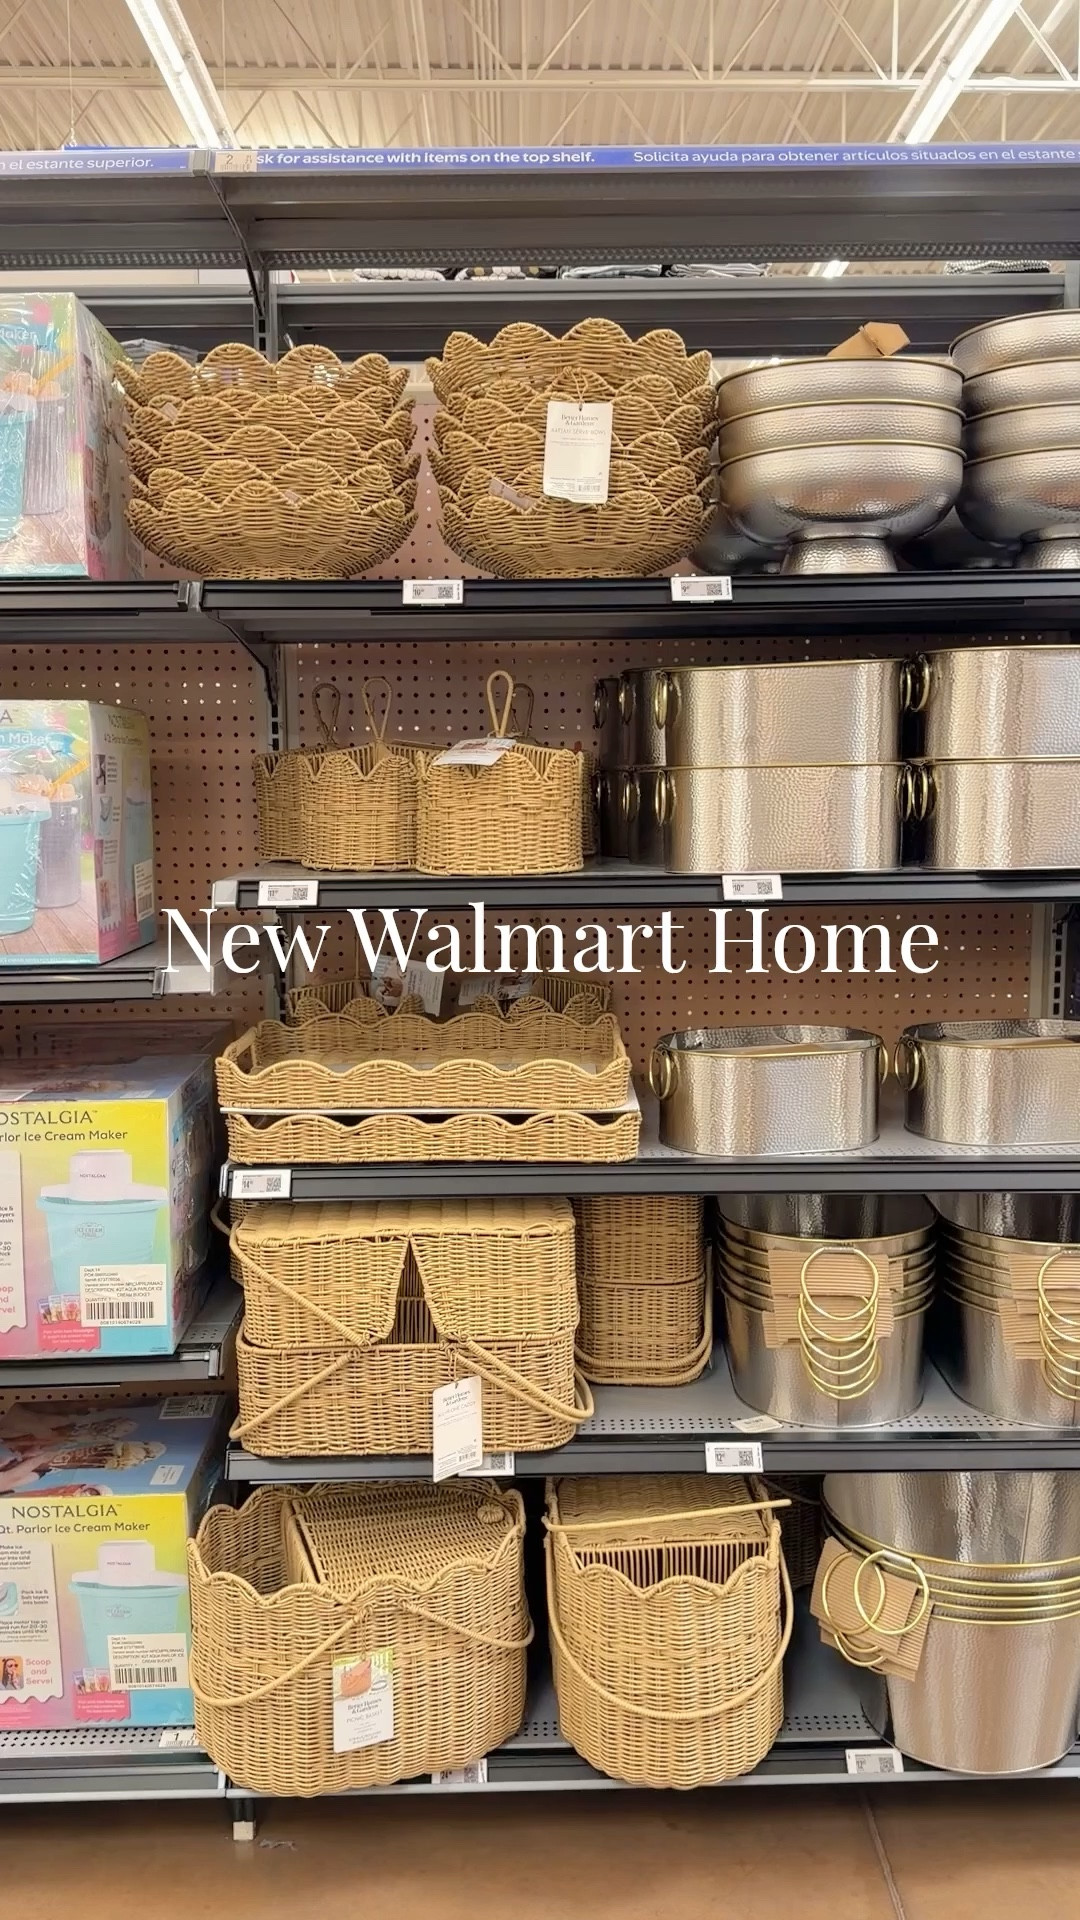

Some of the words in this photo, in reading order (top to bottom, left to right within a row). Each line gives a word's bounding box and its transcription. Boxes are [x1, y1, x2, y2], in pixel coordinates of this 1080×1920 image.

[277, 153, 301, 164] for
[302, 153, 384, 164] assistance
[387, 152, 421, 163] with
[424, 152, 467, 163] items
[470, 154, 491, 163] on
[494, 152, 520, 163] the
[523, 152, 550, 164] top
[552, 151, 595, 162] shelf.
[633, 151, 689, 162] Solicita
[692, 152, 738, 163] ayuda
[741, 153, 775, 163] para
[778, 151, 839, 162] obtener
[842, 149, 908, 161] artículos
[911, 149, 975, 160] situados
[981, 151, 998, 160] en
[1001, 149, 1015, 160] el
[1019, 149, 1076, 160] estante
[9, 159, 23, 170] el
[26, 159, 84, 170] estante
[86, 157, 154, 170] superior.
[24, 1131, 42, 1142] Ice
[44, 1130, 86, 1141] Cream
[89, 1129, 128, 1140] Maker
[16, 1524, 52, 1534] Parlor
[55, 1524, 71, 1533] Ice
[74, 1523, 112, 1533] Cream
[115, 1522, 151, 1532] Maker
[25, 1658, 52, 1667] Scoop
[31, 1668, 48, 1676] and
